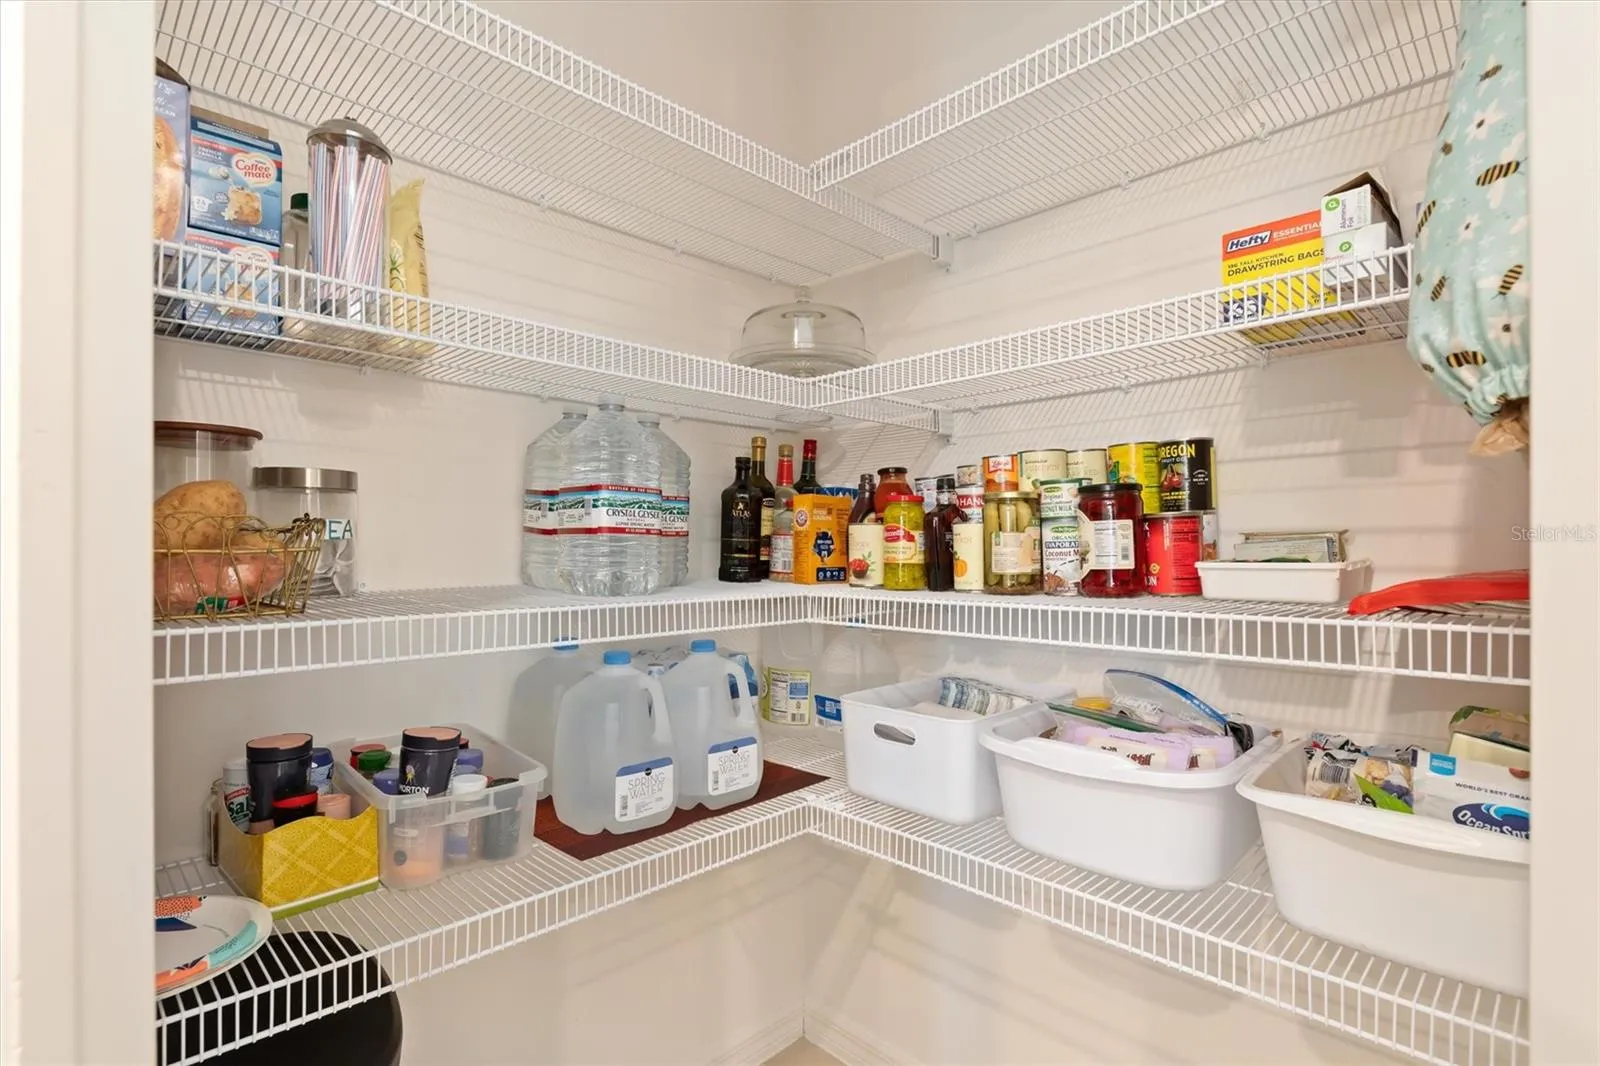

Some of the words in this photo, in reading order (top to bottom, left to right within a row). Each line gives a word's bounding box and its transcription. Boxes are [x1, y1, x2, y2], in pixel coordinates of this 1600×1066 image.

[235, 159, 271, 172] Coffee
[243, 169, 272, 180] mate
[1229, 233, 1269, 251] Hefty
[1273, 221, 1321, 238] ESSENTIA
[1227, 255, 1295, 277] DRAWSTRING
[1297, 247, 1325, 261] BAGS
[1240, 258, 1254, 266] TALL
[1256, 252, 1284, 264] KITCHEN
[1157, 443, 1195, 458] REGON
[606, 508, 637, 518] CRYSTAL
[731, 509, 752, 518] ATLAS
[328, 519, 353, 540] EA
[1045, 541, 1079, 549] EVAPORAT
[1044, 549, 1072, 557] Coconut
[628, 771, 666, 790] SPRING
[628, 782, 664, 800] WATER
[1457, 809, 1501, 833] Ocean
[1502, 825, 1530, 839] Spr
